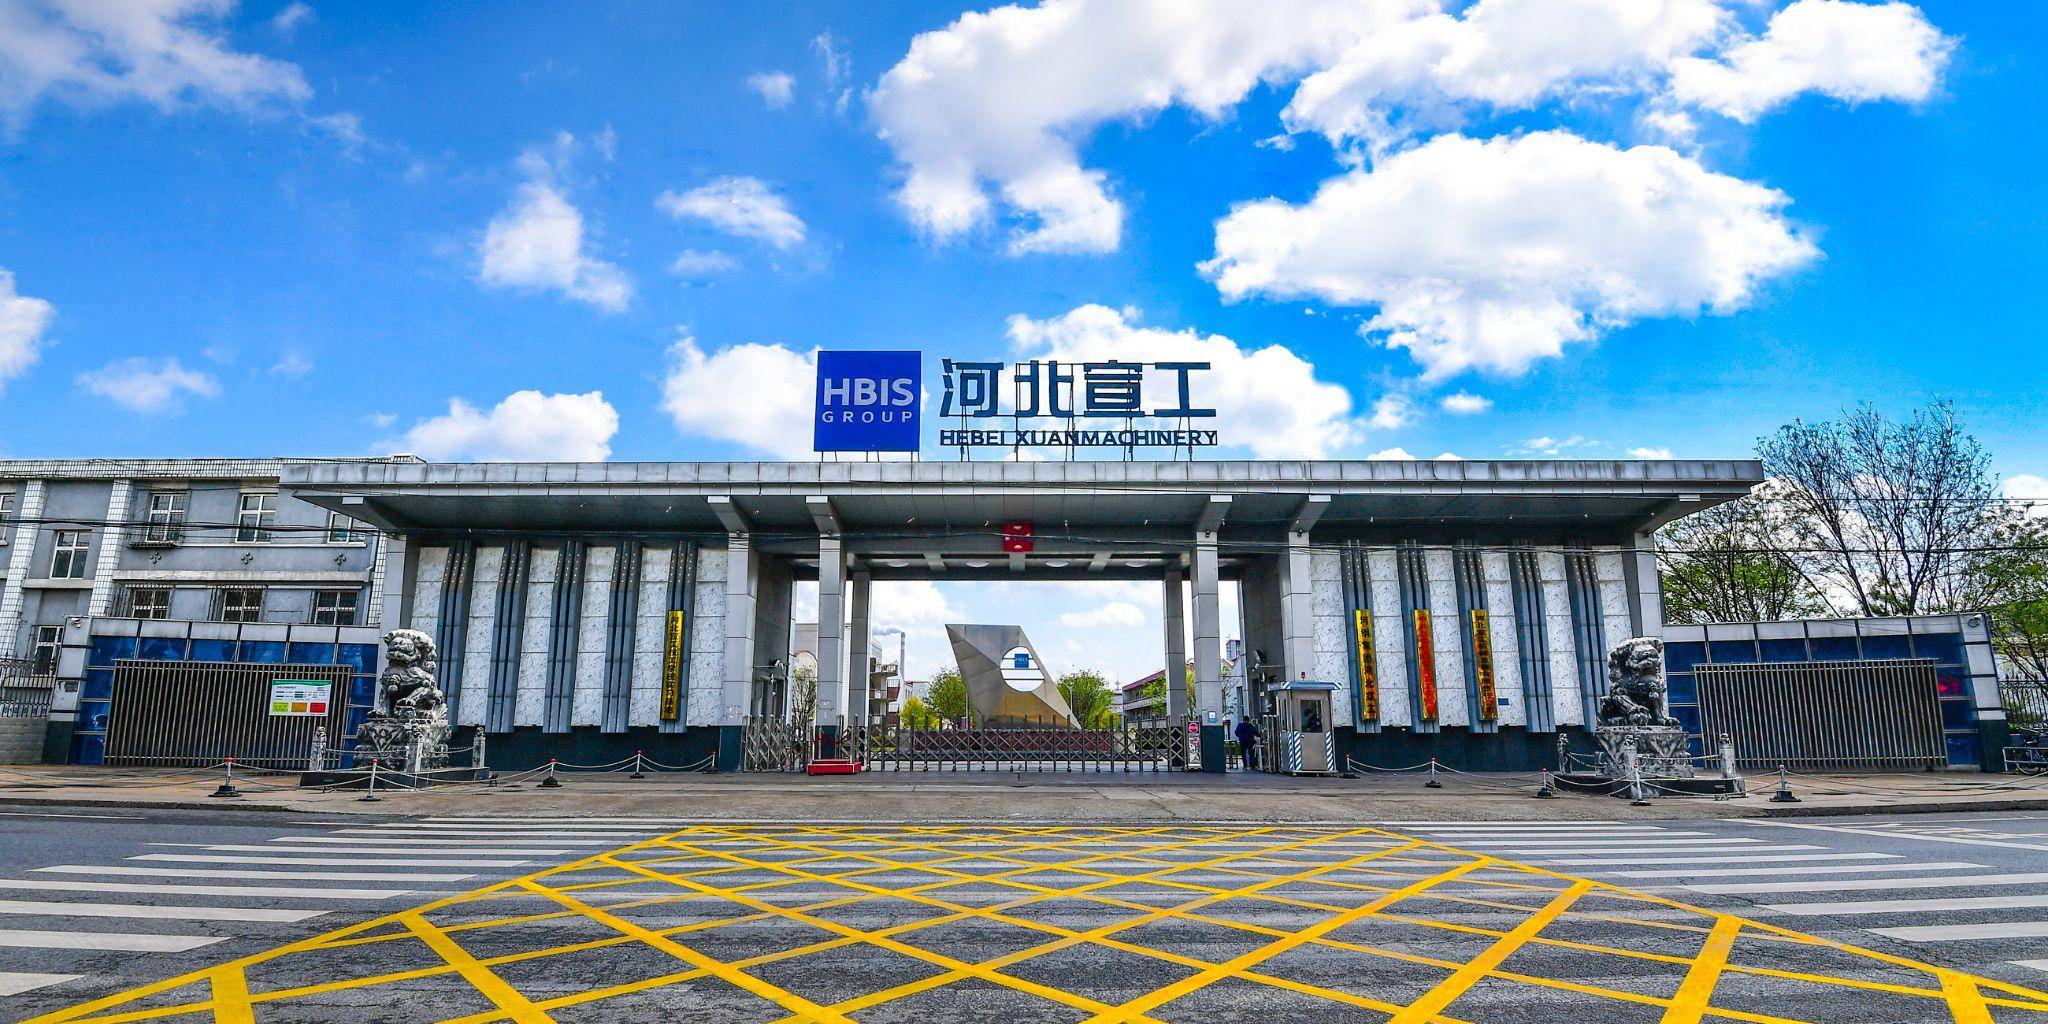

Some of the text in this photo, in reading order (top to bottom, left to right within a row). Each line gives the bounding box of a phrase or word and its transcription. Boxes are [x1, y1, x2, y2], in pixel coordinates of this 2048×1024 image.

[824, 377, 915, 406] HBIS
[939, 358, 1217, 418] 河北宣工
[822, 411, 913, 424] GROUP
[940, 430, 1004, 446] HEBEI
